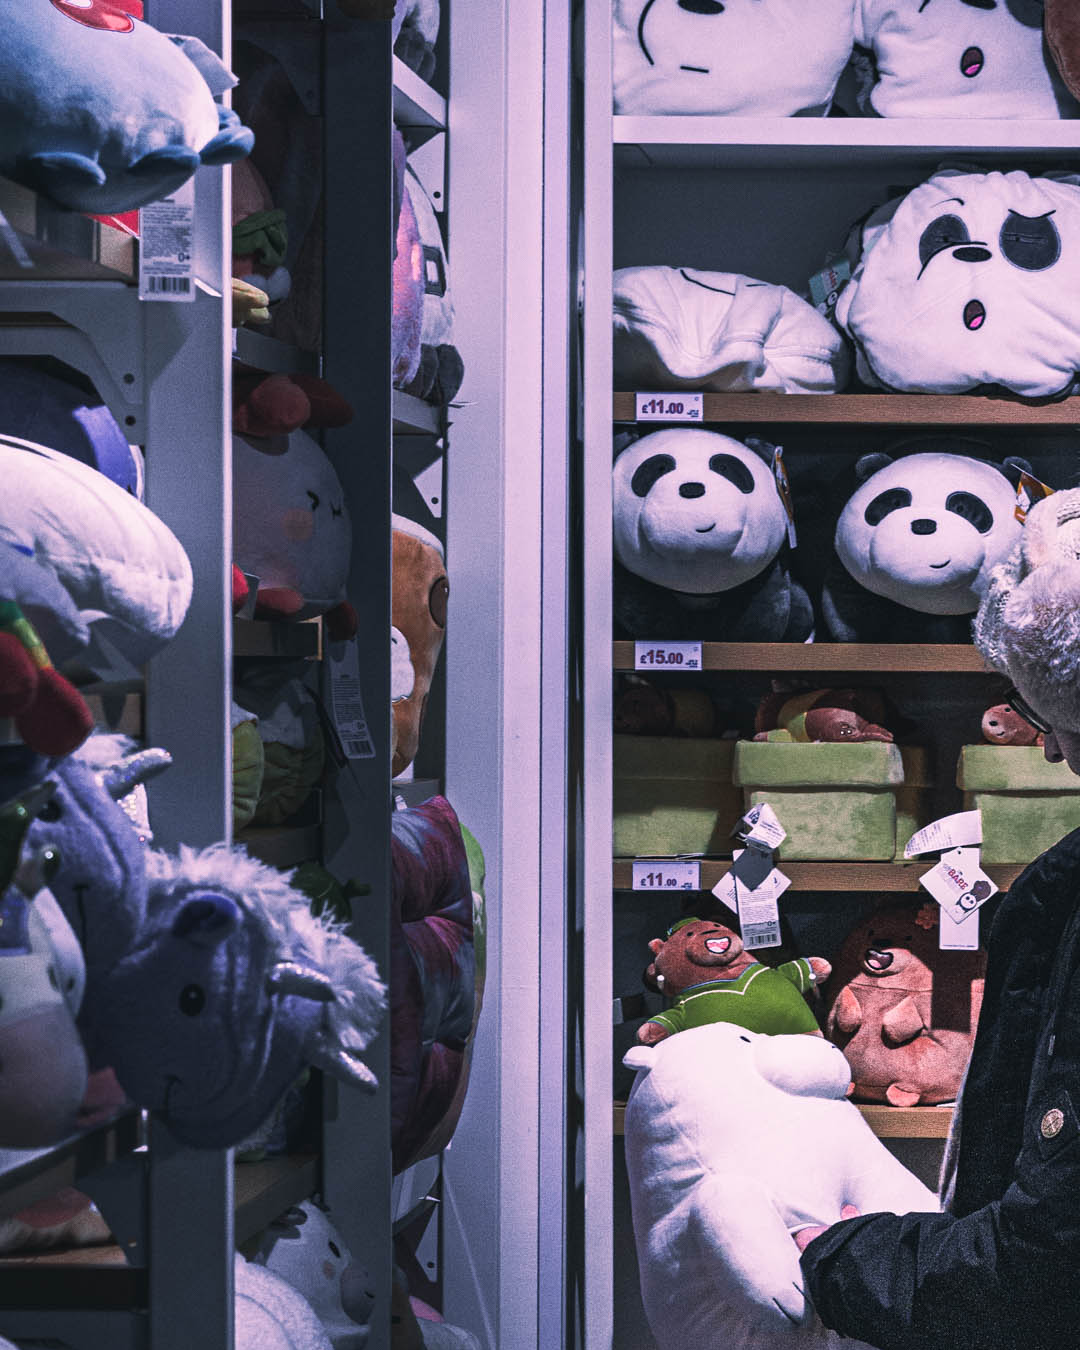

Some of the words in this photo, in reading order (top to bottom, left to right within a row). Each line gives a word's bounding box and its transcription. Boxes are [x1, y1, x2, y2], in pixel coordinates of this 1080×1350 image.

[641, 399, 684, 415] £11.00
[640, 649, 684, 665] £15.00
[641, 872, 678, 887] £11.00
[947, 867, 969, 891] BARE
